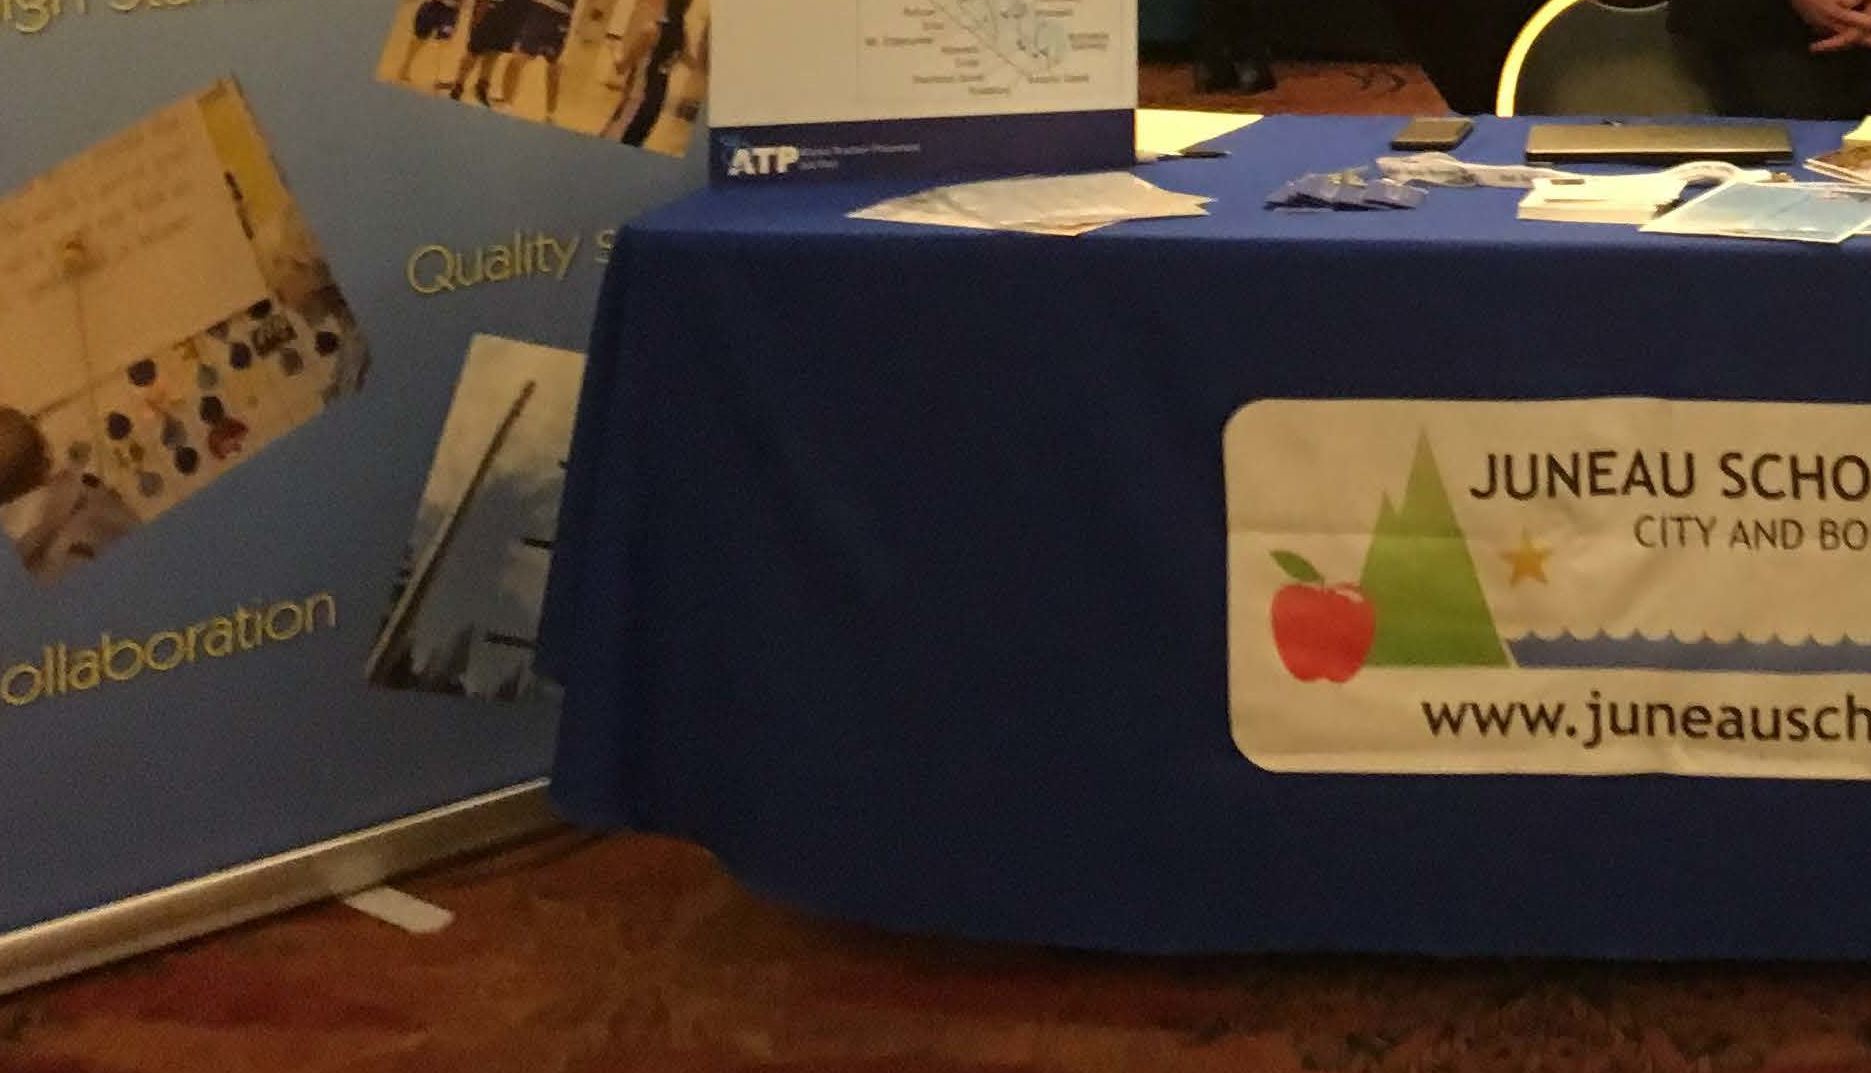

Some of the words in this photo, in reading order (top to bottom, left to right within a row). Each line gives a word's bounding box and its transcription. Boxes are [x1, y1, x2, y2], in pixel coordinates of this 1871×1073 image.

[728, 146, 799, 175] ATP
[406, 228, 578, 294] Quality
[1469, 452, 1696, 501] JUNEAU
[1634, 516, 1714, 550] CITY
[1728, 518, 1800, 551] AND
[0, 590, 336, 706] ollaboration
